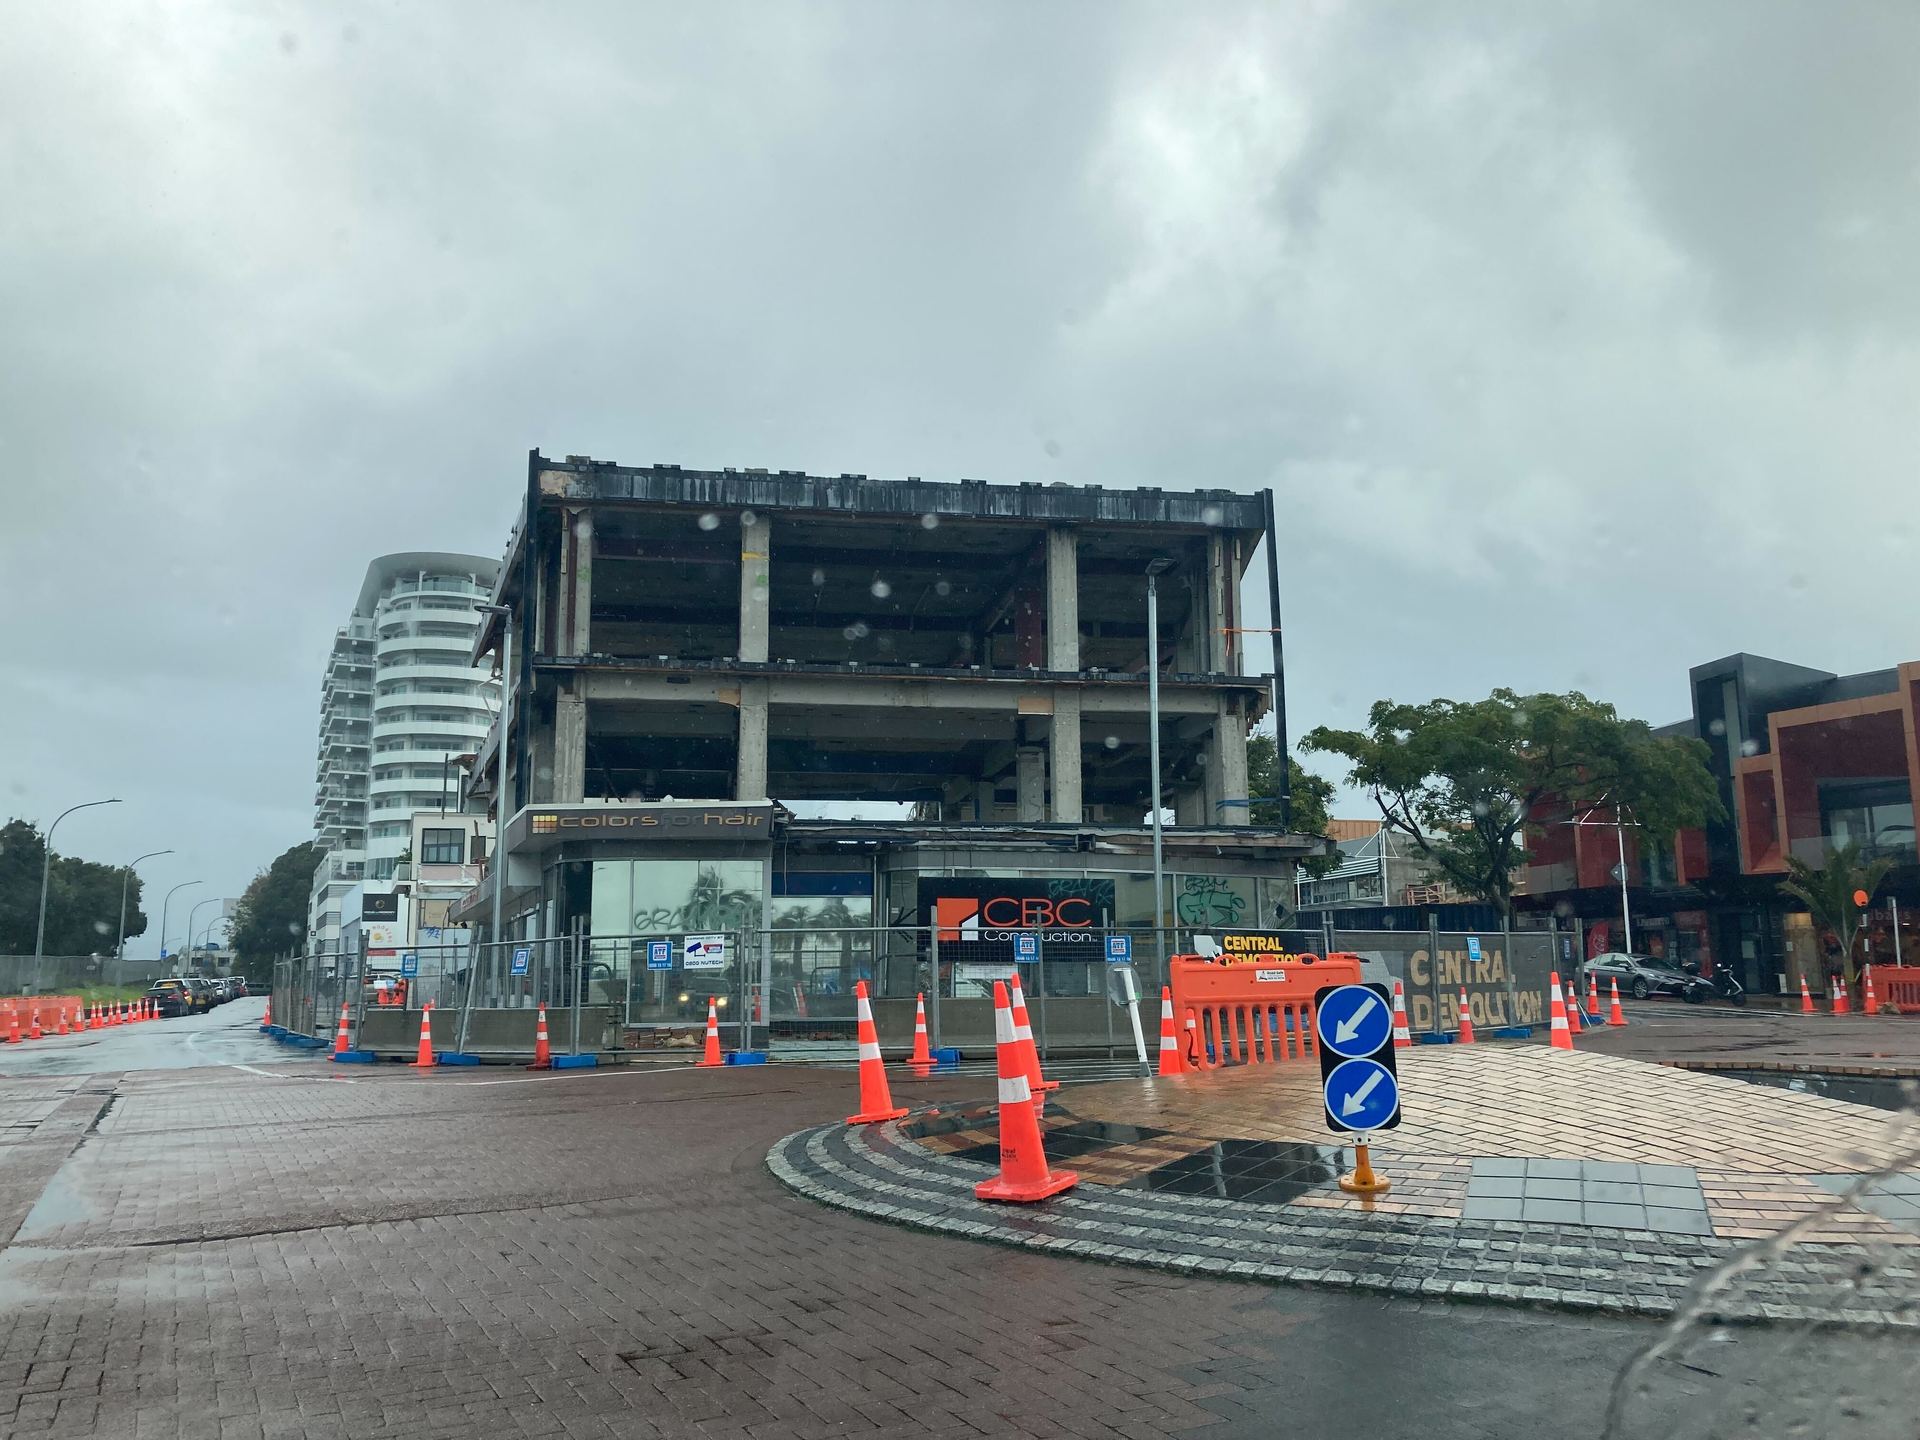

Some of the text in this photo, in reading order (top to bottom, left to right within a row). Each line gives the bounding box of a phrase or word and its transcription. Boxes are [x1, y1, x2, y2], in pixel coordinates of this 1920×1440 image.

[983, 897, 1092, 928] CBC
[984, 930, 1092, 943] Conuction
[1224, 935, 1284, 951] CENTRAL
[1410, 949, 1517, 986] CENTRA
